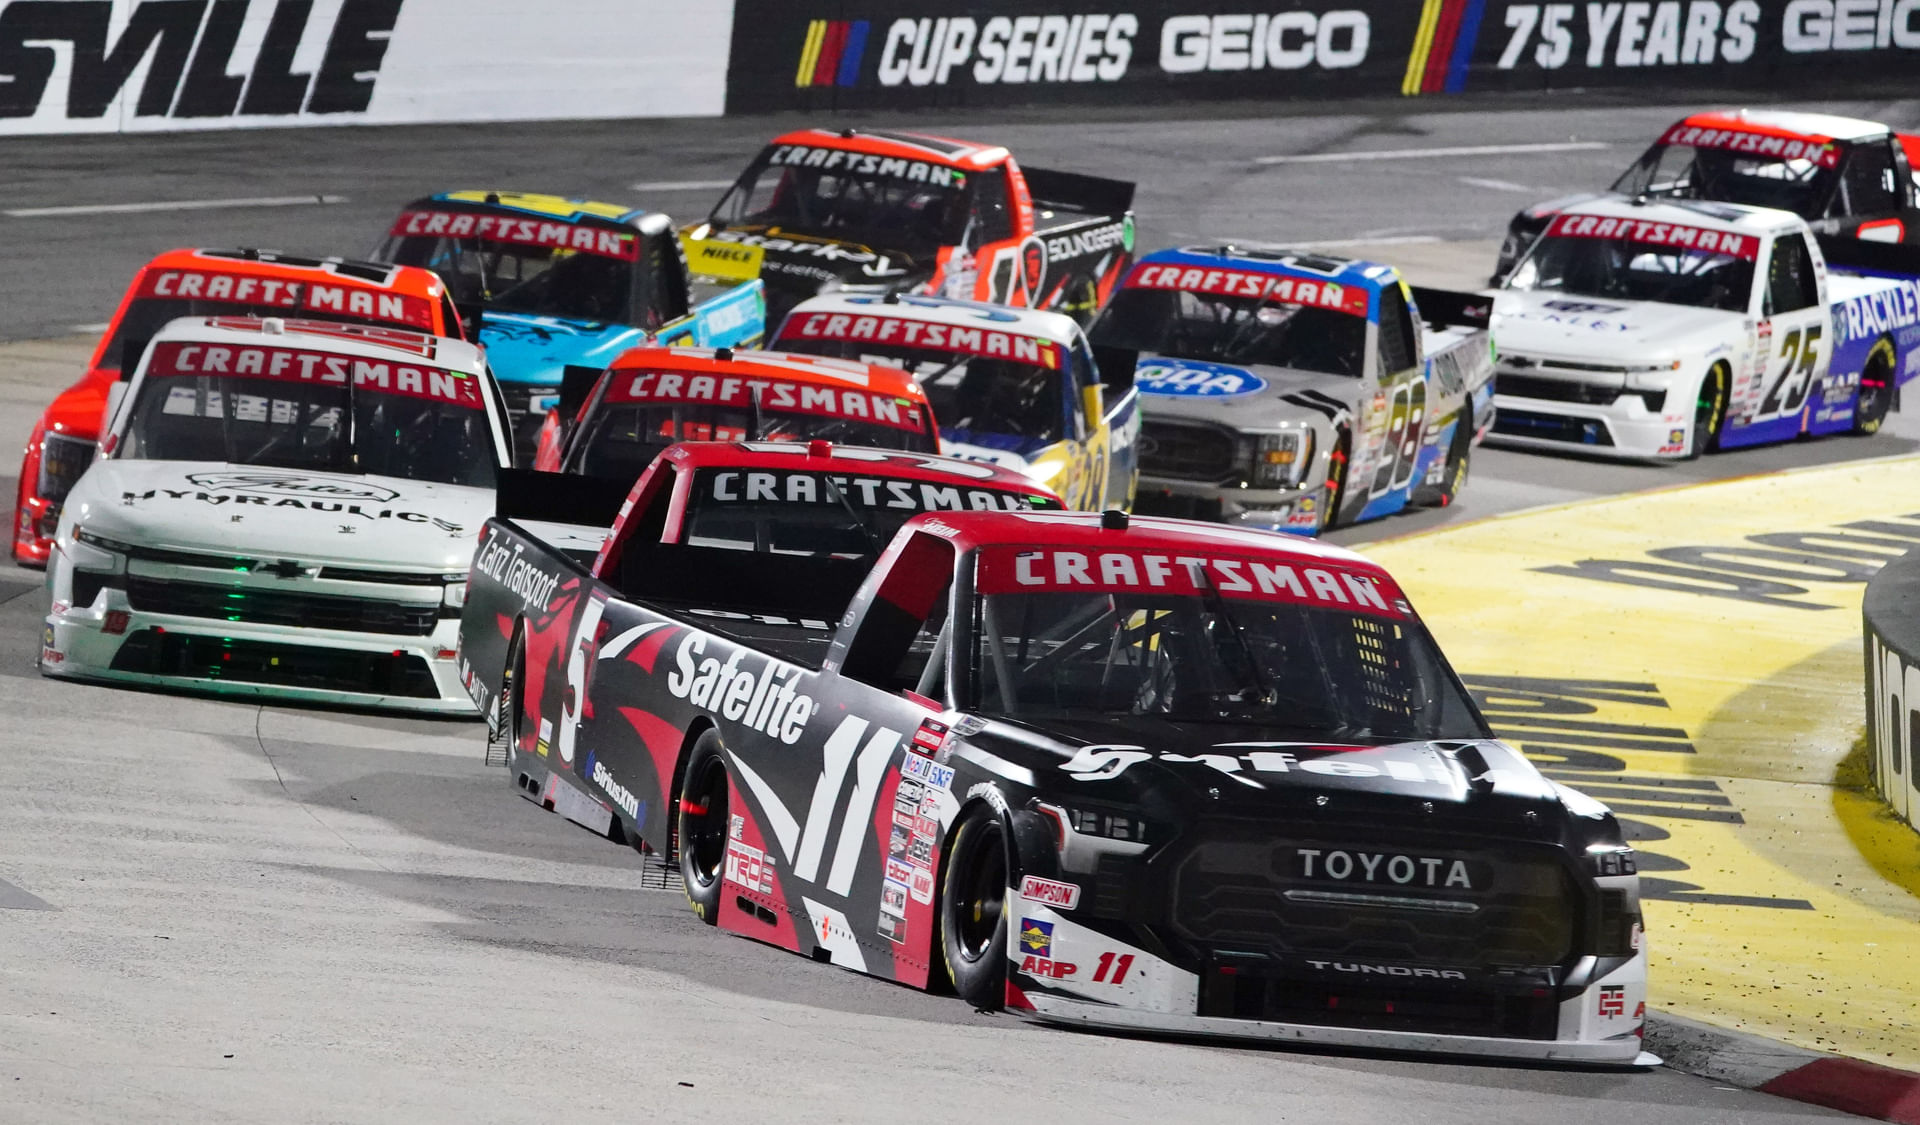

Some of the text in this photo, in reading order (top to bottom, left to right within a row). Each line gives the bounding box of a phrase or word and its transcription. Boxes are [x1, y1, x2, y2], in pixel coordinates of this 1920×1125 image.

[878, 10, 1370, 86] CUP SERIES GEICO
[1498, 4, 1574, 70] 75
[1585, 1, 1760, 68] YEARS
[769, 143, 951, 186] CRAFTSMAN
[1668, 126, 1826, 163] CRAFTSMAN
[407, 212, 622, 256] CRAFTSMAN
[702, 247, 753, 262] NIECE
[1561, 217, 1743, 256] CRAFTSMAN
[154, 272, 405, 322] CRAFTSMAN
[1139, 266, 1342, 308] CRAFTSMAN
[803, 313, 1038, 361] CRAFTSMAN
[176, 346, 456, 400] CRAFTSMAN
[1752, 322, 1824, 423] 25
[629, 374, 898, 424] CRAFTSMAN
[122, 489, 464, 533] HYDRAULICS
[921, 523, 960, 538] HEIM
[503, 544, 560, 612] Transport
[1016, 551, 1389, 611] CRAFTSMAN
[668, 631, 812, 745] Safelite
[928, 766, 953, 788] SKF
[794, 714, 903, 897] 11
[726, 848, 763, 892] TRD
[1297, 849, 1472, 889] TOYOTA
[1023, 880, 1073, 905] SIMPSON
[1021, 955, 1078, 979] ARP
[1092, 951, 1136, 985] 11
[1305, 959, 1466, 981] TUNDRA
